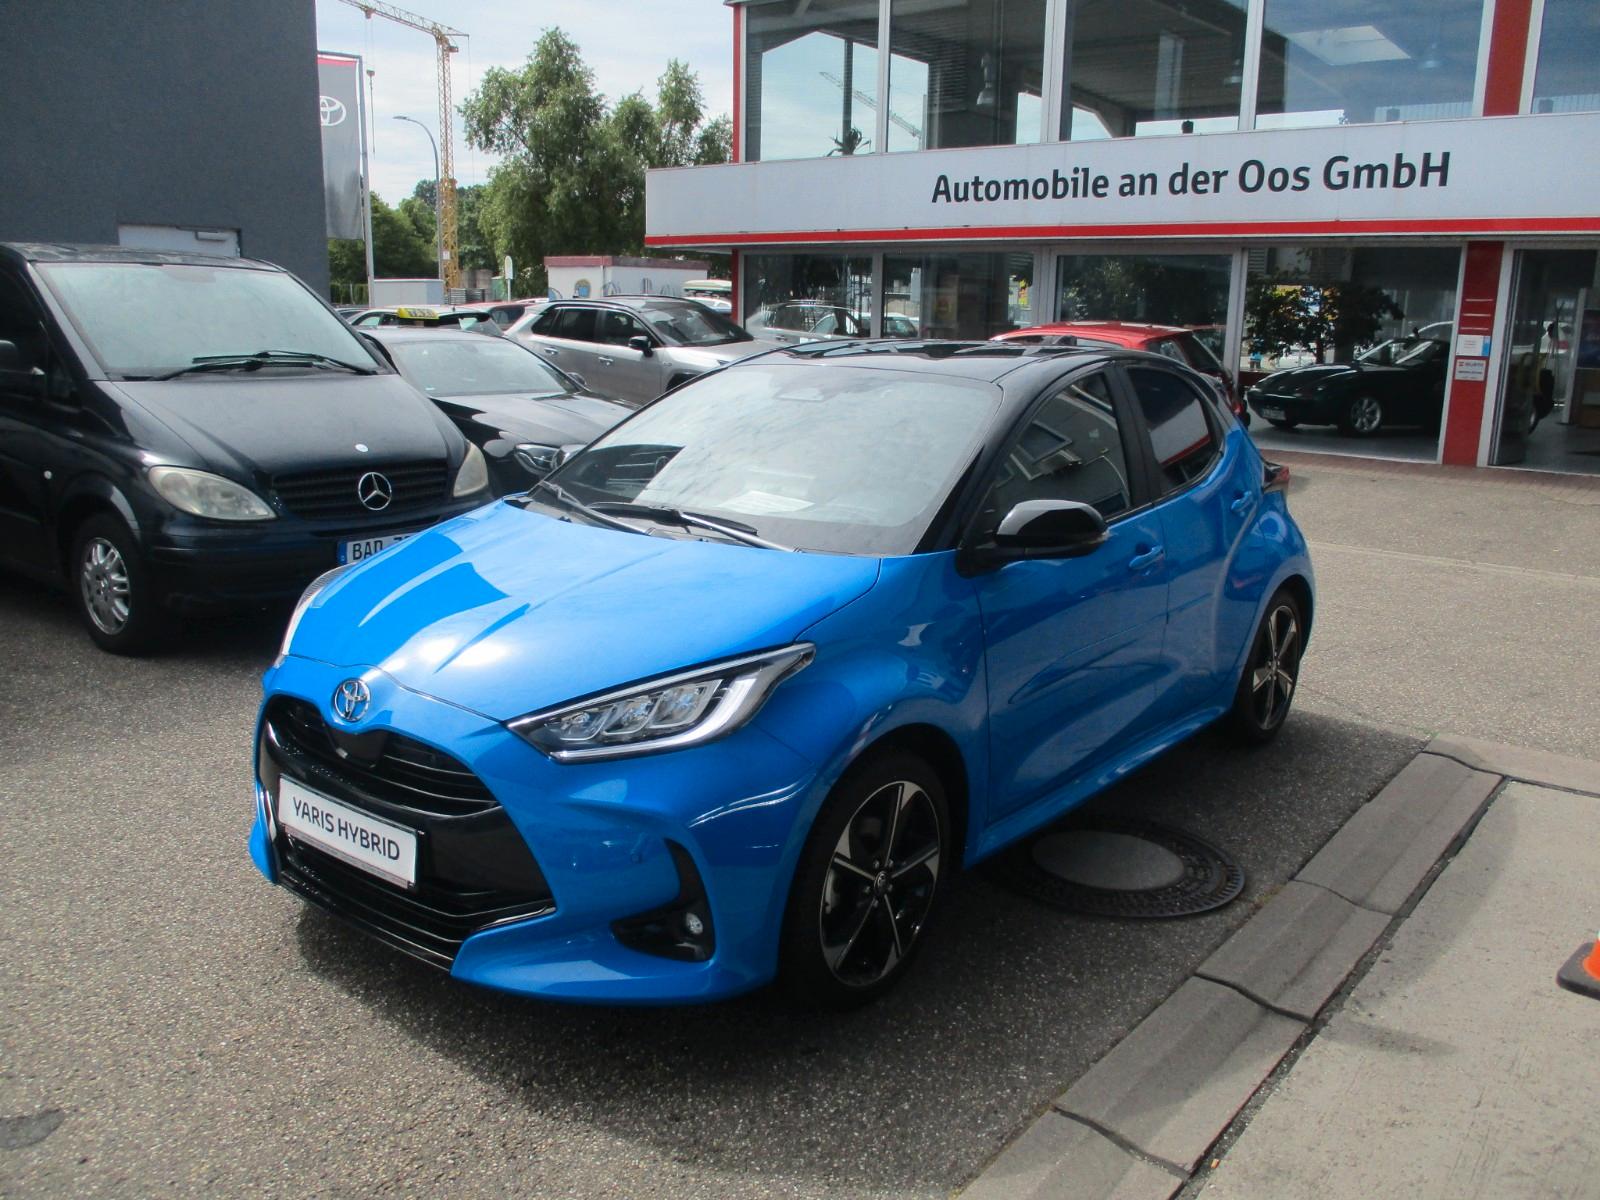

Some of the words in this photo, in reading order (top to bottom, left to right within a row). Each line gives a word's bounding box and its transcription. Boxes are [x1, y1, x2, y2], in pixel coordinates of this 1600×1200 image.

[931, 167, 1109, 204] Automobile
[1118, 173, 1158, 196] an
[1168, 162, 1229, 196] der
[1238, 159, 1311, 194] Oos
[1322, 151, 1451, 192] GmbH
[292, 796, 335, 834] YARIS
[337, 818, 401, 861] HYBRID
